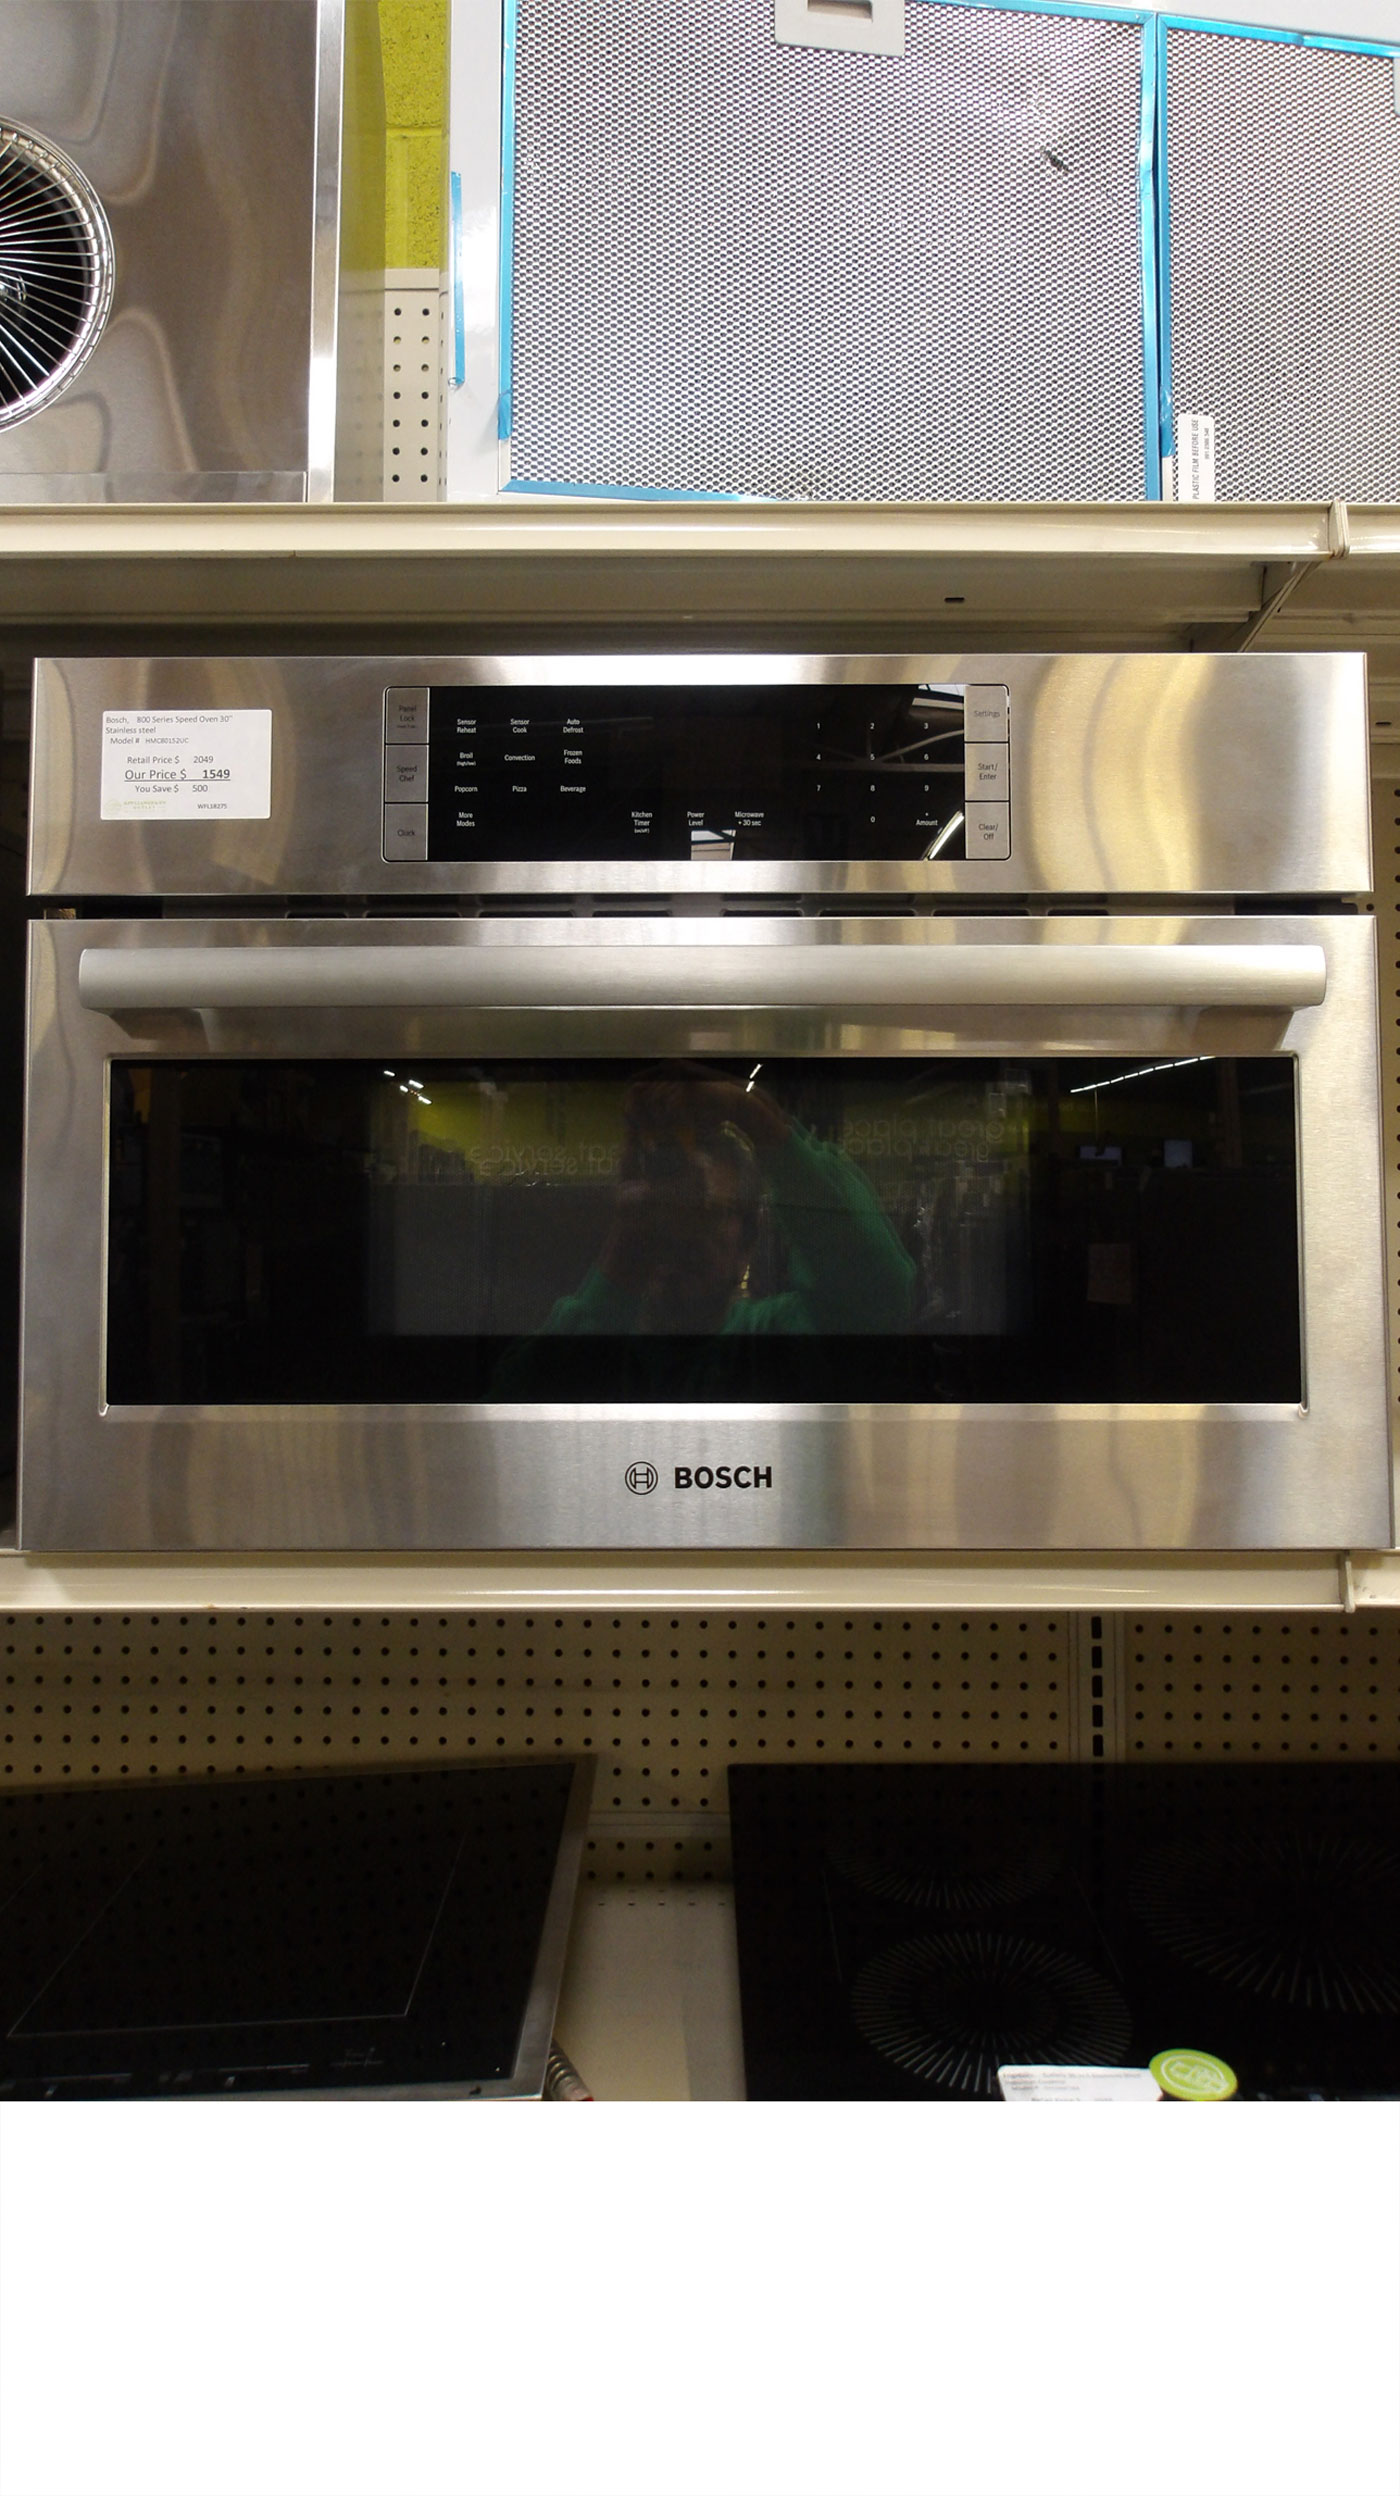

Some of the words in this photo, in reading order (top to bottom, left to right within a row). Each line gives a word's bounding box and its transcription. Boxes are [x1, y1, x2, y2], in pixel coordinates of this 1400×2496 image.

[1191, 418, 1199, 431] USE
[1191, 432, 1199, 456] BEFORE
[1191, 458, 1200, 473] FILM
[1191, 474, 1200, 500] PLASTIC
[973, 710, 1001, 718] Settings
[175, 715, 198, 724] Speed
[199, 715, 218, 723] Oven
[456, 718, 477, 726] Sensor
[510, 718, 530, 726] Sensor
[566, 718, 581, 726] Auto
[456, 726, 477, 734] Reheat
[512, 726, 528, 734] Cook
[562, 726, 584, 734] Defrost
[459, 752, 474, 760] Broil
[563, 749, 583, 757] Frozen
[127, 756, 151, 764] Retail
[152, 756, 172, 764] Price
[174, 755, 180, 764] $
[193, 755, 214, 764] 2049
[504, 754, 536, 762] Convection
[564, 757, 582, 765] Foods
[396, 766, 418, 774] Speed
[977, 762, 998, 772] Start/
[125, 769, 146, 780] Our
[149, 769, 177, 779] Price
[180, 768, 187, 781] $
[202, 769, 230, 779] 1549
[978, 771, 998, 781] Enter
[135, 784, 151, 792] You
[152, 784, 172, 792] Save
[173, 783, 180, 793] $
[192, 784, 208, 792] 500
[454, 785, 478, 794] Popcorn
[512, 785, 528, 793] Pizza
[560, 785, 587, 794] Beverage
[631, 811, 653, 819] Kitchen
[687, 811, 705, 819] Power
[734, 811, 765, 819] Microwave
[456, 820, 476, 828] Modes
[633, 819, 650, 827] Timer
[688, 819, 704, 827] Level
[751, 819, 762, 827] sec
[915, 819, 938, 827] Amount
[978, 823, 998, 832] Clear/
[983, 832, 995, 841] Off
[674, 1466, 772, 1489] BOSCH
